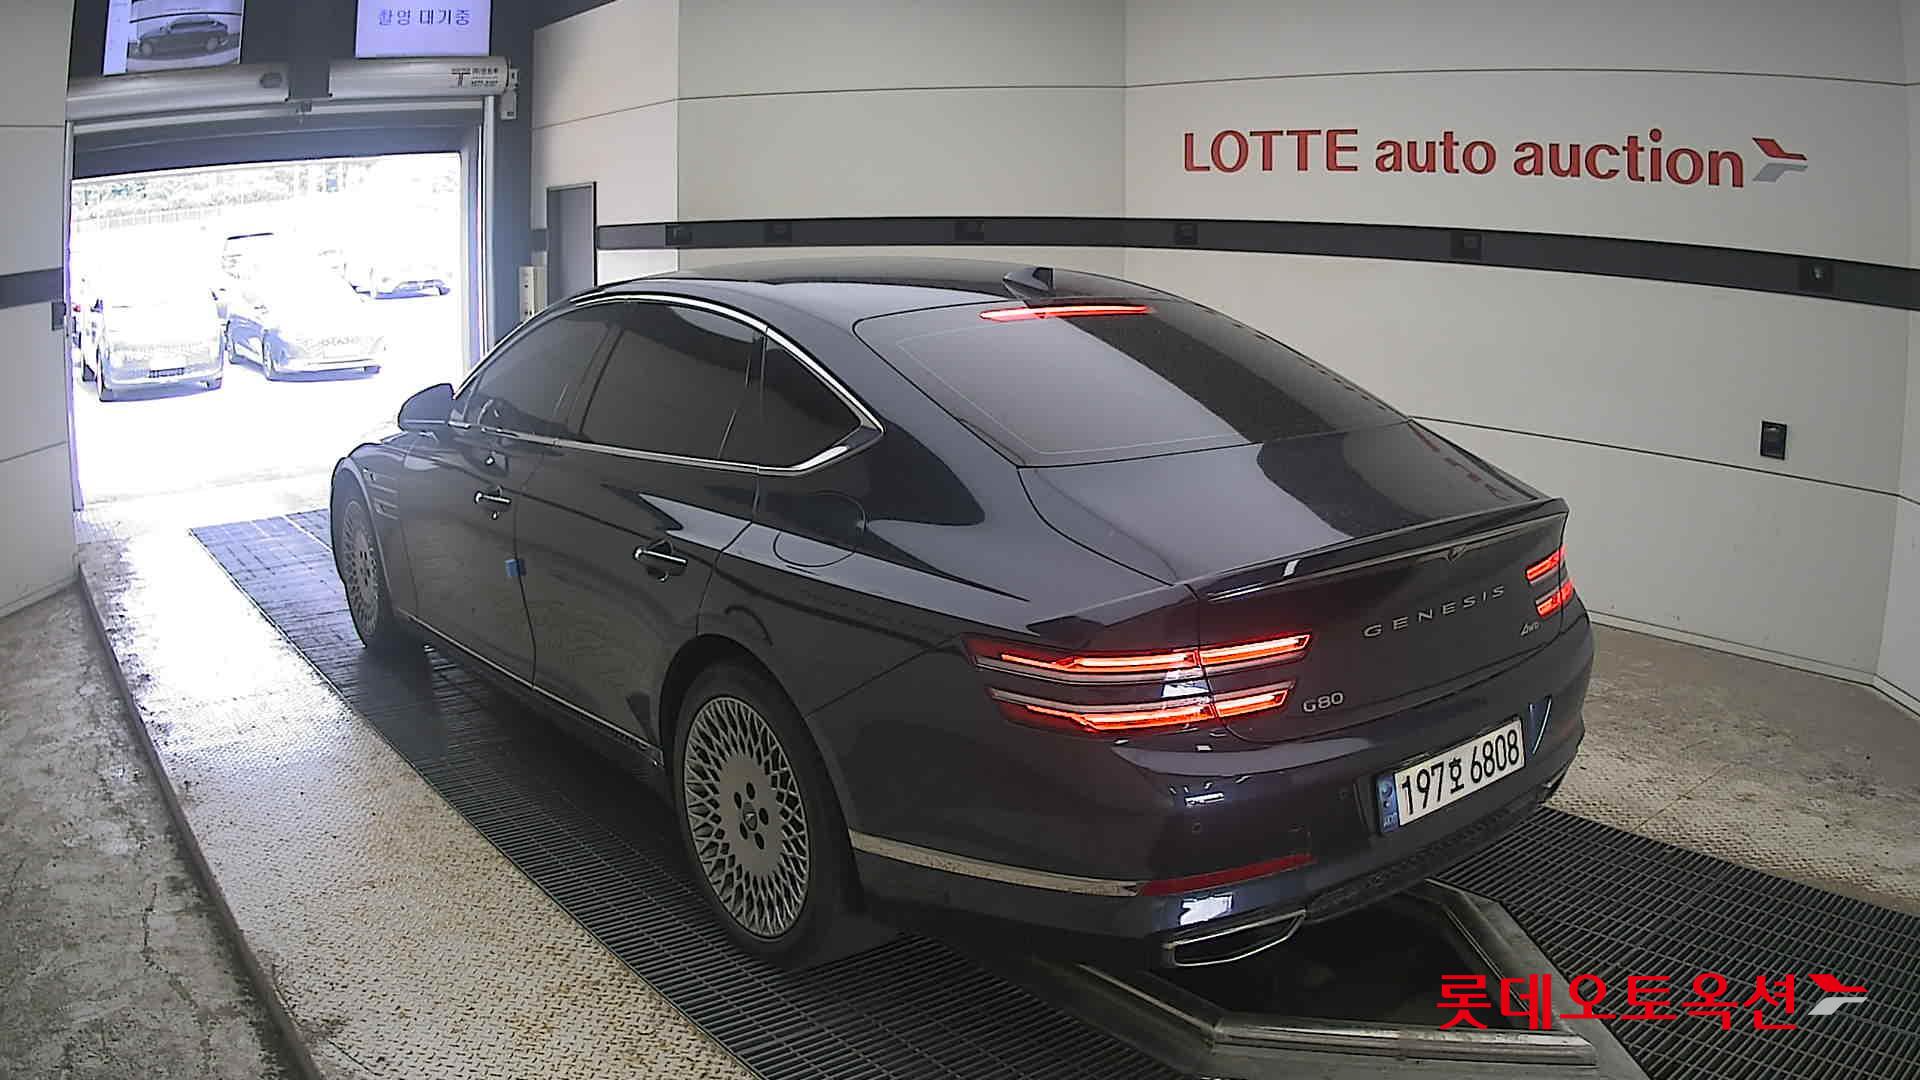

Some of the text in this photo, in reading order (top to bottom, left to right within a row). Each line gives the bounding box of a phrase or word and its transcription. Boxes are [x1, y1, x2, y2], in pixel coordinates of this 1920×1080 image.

[419, 9, 471, 26] 대기중
[1184, 128, 1744, 187] LOTTE auto auction
[1363, 585, 1505, 638] GENESIS
[1302, 691, 1344, 713] G80
[1470, 729, 1520, 784] 6808
